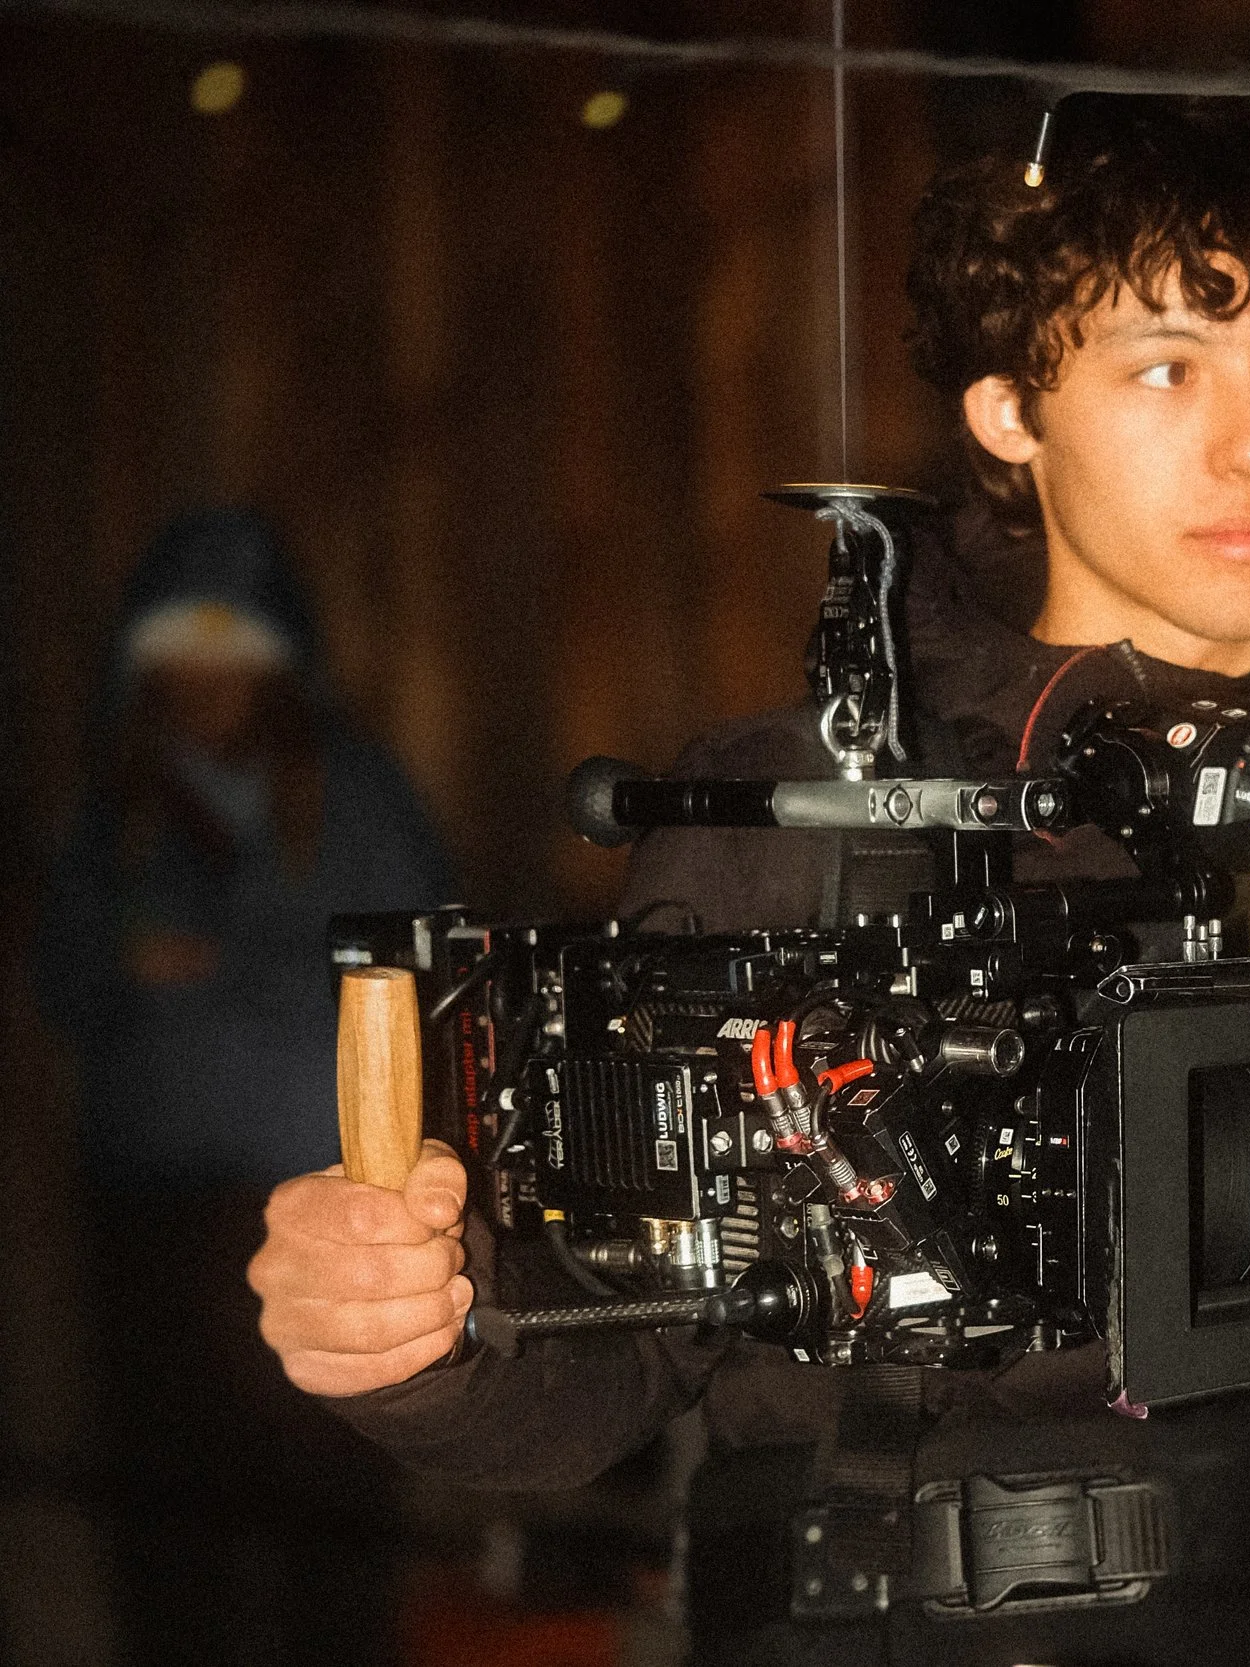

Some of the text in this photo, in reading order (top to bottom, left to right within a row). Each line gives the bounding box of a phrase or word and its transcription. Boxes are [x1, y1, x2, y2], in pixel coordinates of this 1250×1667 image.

[717, 1018, 760, 1040] ARRI
[655, 1082, 669, 1139] LUDWIG
[994, 1146, 1014, 1161] Cooke
[997, 1194, 1010, 1207] 50
